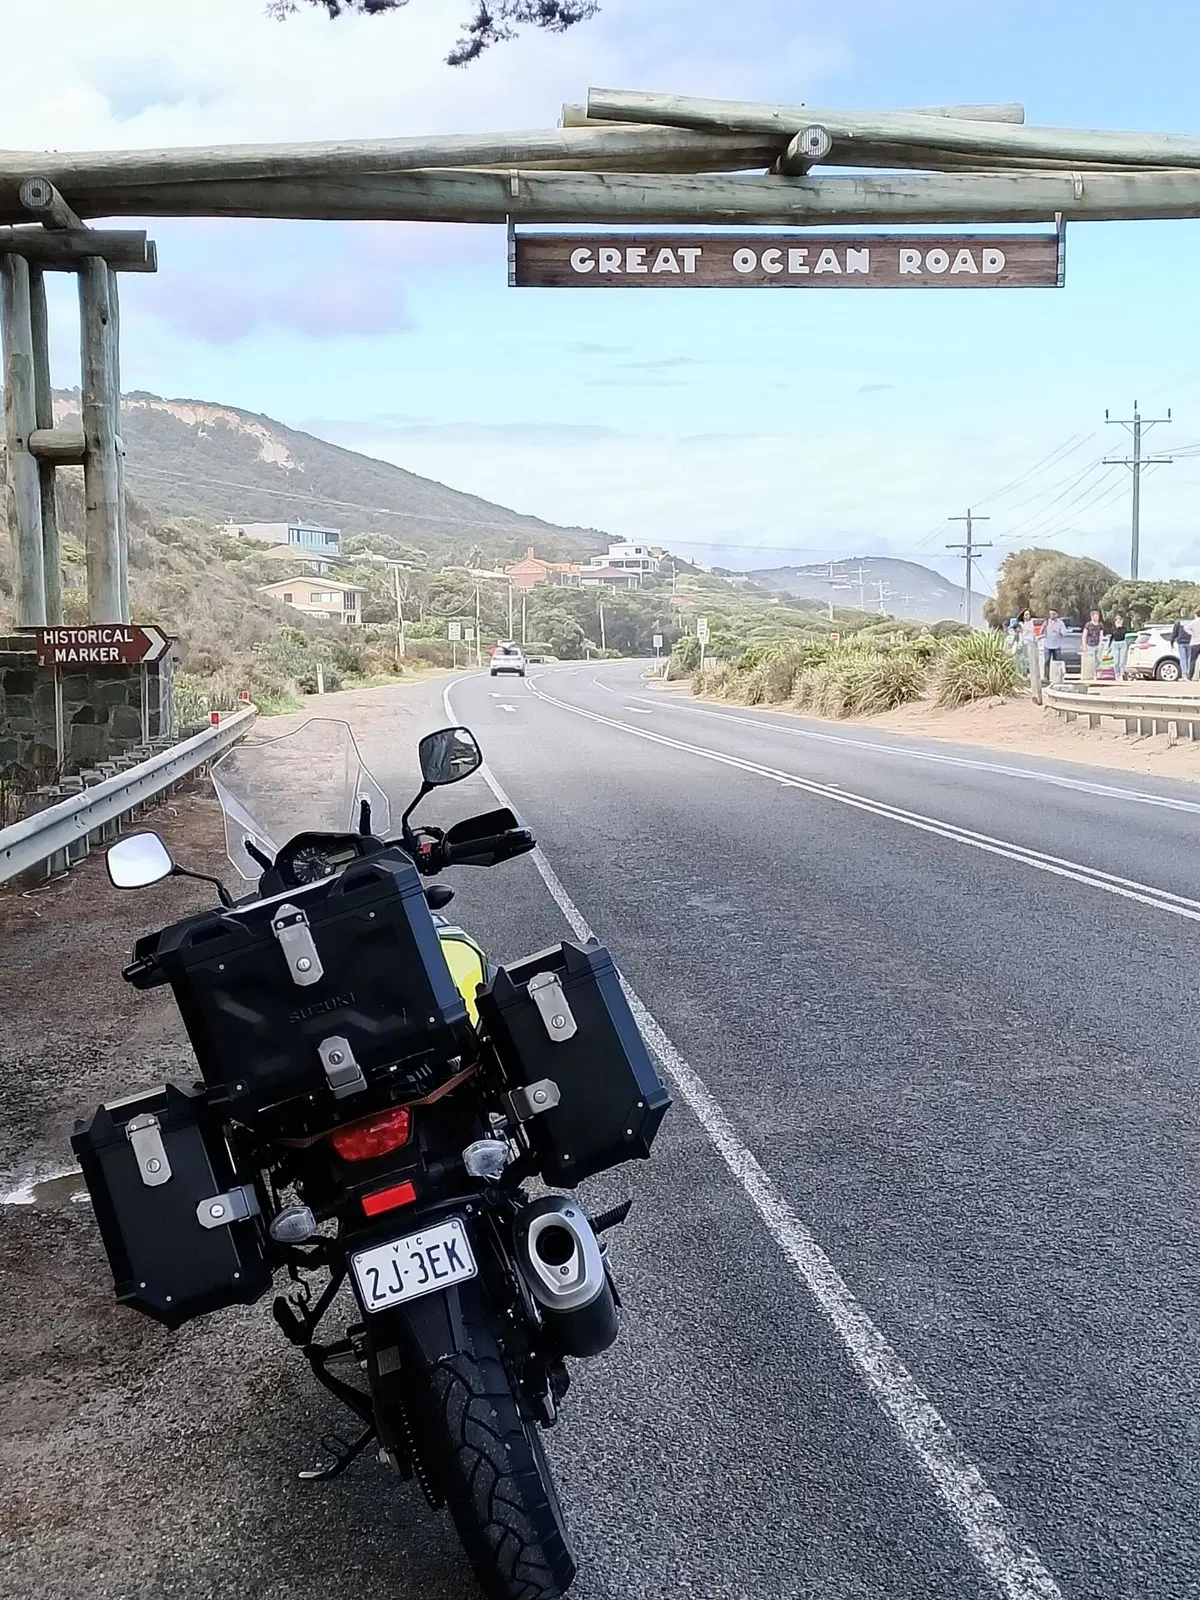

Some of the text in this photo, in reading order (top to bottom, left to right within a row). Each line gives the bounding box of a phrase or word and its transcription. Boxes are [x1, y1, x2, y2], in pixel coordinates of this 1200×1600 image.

[570, 248, 1006, 274] GREAT OCEAN ROAD
[43, 629, 133, 644] HISTORICAL
[54, 647, 119, 662] MARKER
[289, 992, 355, 1023] SUZUKI
[392, 1237, 423, 1254] VIC
